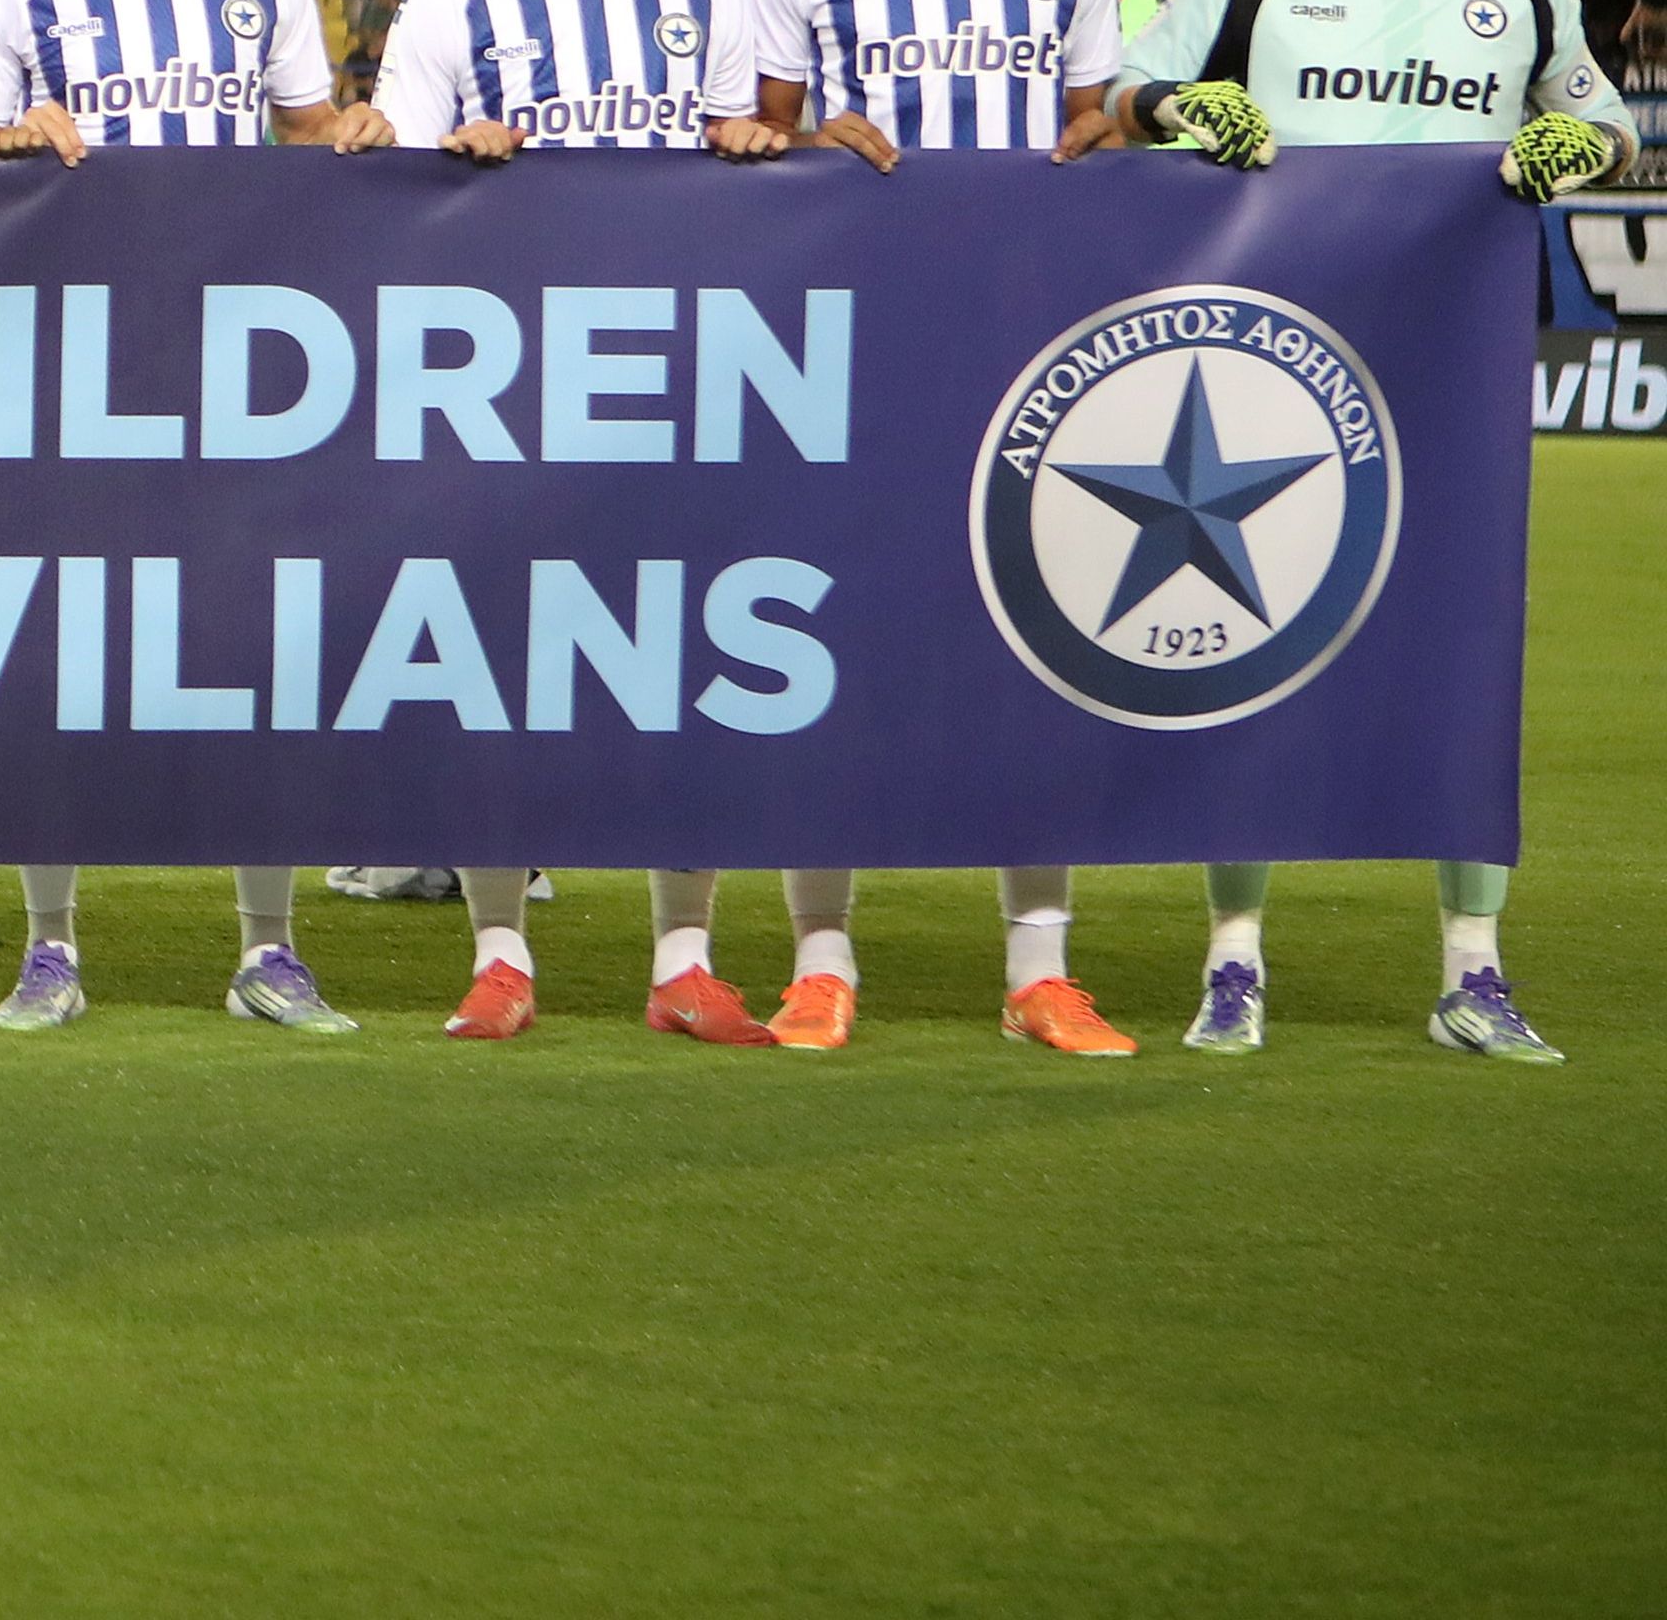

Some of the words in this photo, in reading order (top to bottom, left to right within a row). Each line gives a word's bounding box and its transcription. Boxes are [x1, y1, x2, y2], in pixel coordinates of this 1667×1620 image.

[861, 24, 1060, 74] novibet
[71, 62, 261, 113] novibet
[510, 85, 704, 133] novibet
[1299, 58, 1500, 114] novibet
[1001, 305, 1237, 479] ΑΤΡΟΜΗΤΟΣ
[1240, 315, 1382, 466] ΑΘΗΝΩΝ
[1141, 622, 1228, 658] 1923
